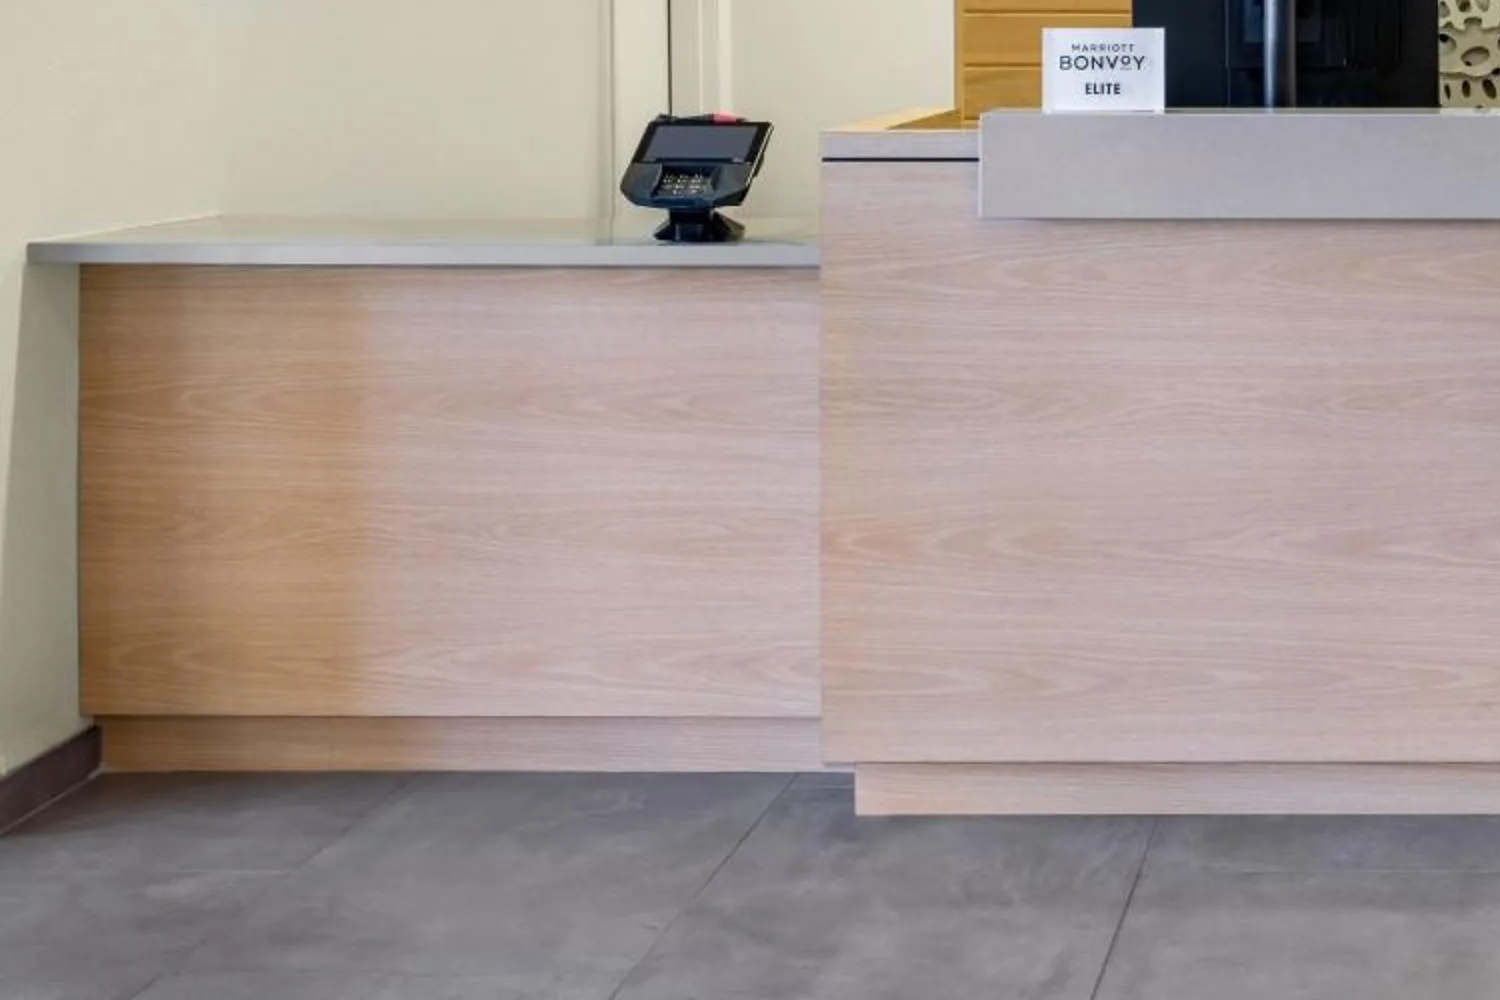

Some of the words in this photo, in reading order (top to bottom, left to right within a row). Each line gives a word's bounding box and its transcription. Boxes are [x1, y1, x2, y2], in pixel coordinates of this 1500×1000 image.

[1071, 43, 1135, 53] MARRIOTT
[1059, 55, 1145, 71] BONVOY
[1085, 82, 1121, 95] ELITE
